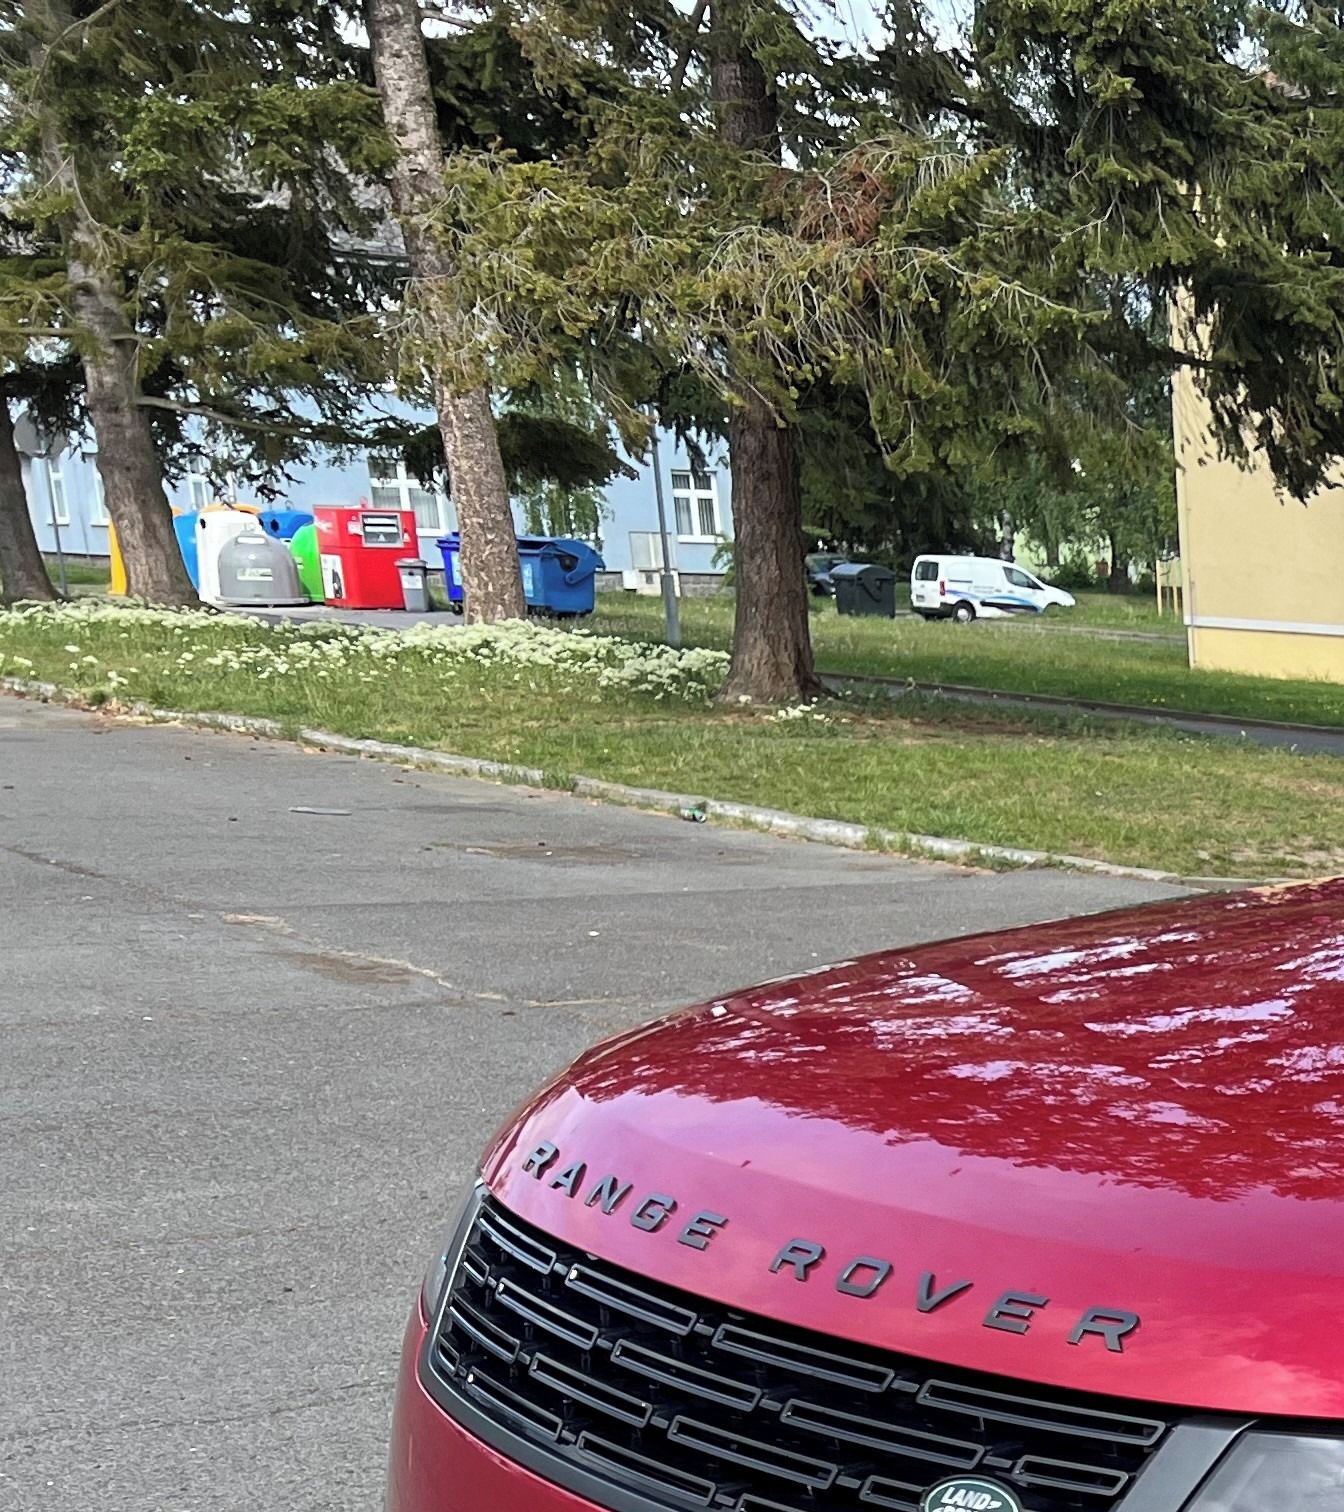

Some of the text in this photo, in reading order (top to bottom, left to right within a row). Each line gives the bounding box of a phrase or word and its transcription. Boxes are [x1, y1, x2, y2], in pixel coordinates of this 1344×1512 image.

[521, 1139, 1142, 1353] RANGE ROVER
[940, 1486, 992, 1510] LAND
